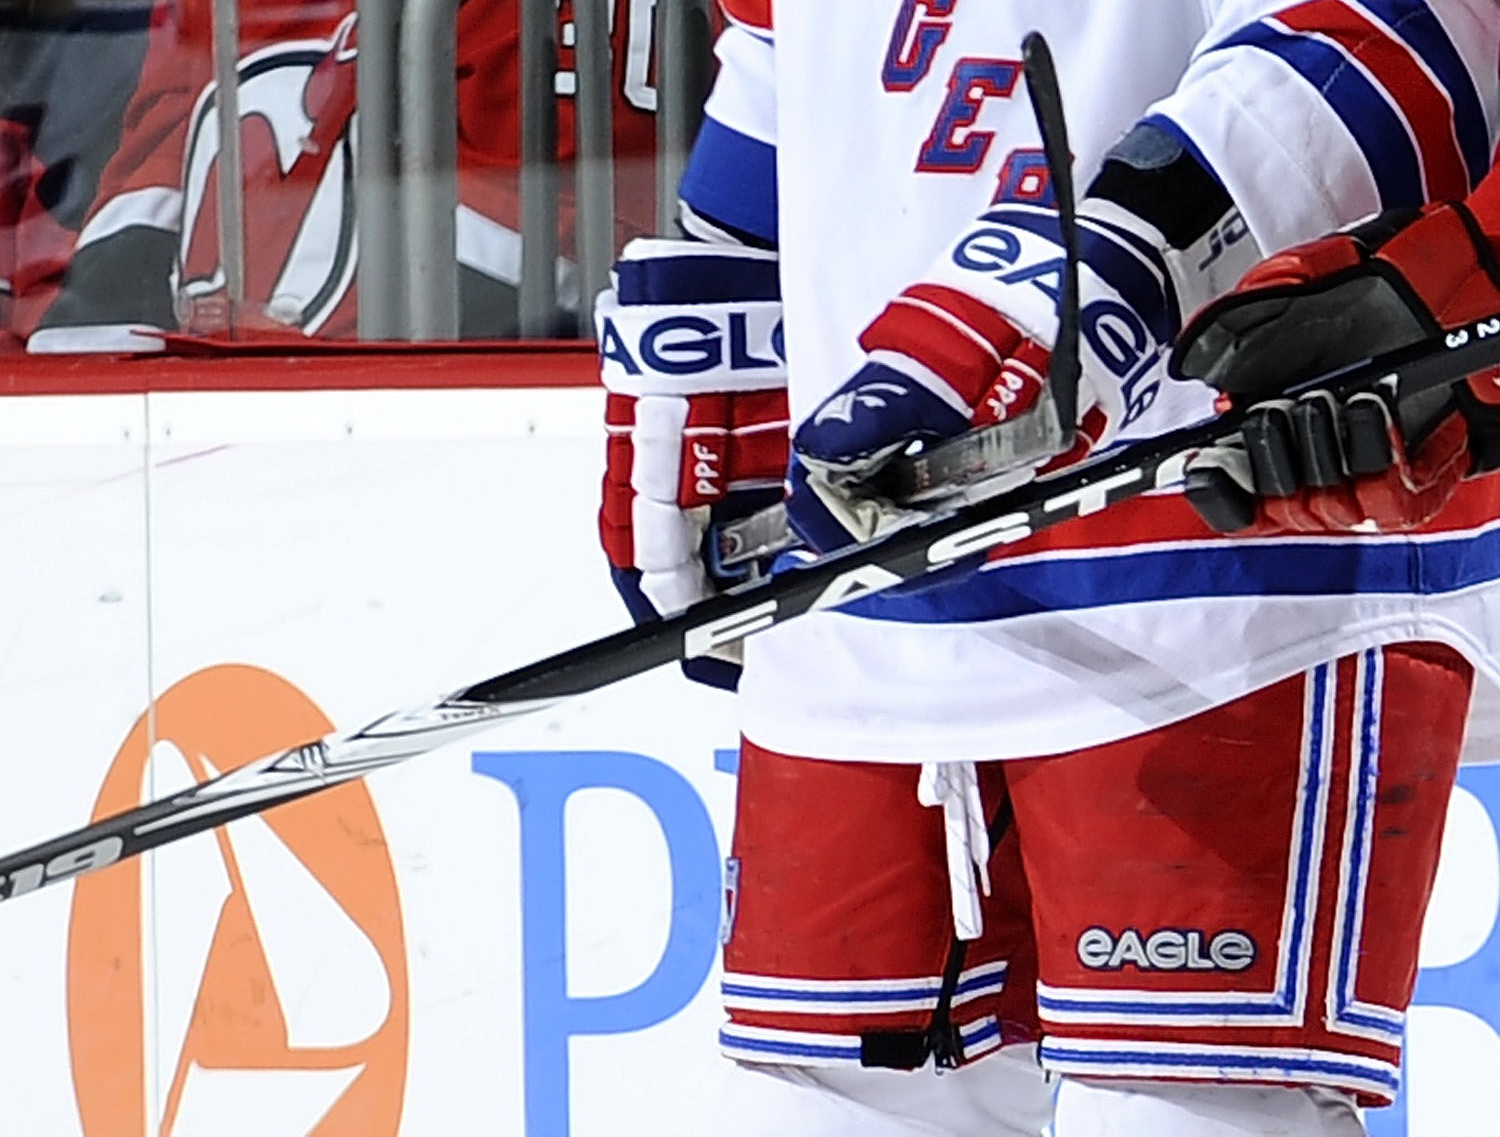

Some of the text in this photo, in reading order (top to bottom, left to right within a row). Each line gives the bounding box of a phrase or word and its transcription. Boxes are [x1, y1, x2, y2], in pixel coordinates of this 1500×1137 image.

[603, 312, 785, 376] AGL
[693, 442, 720, 495] PPF
[684, 450, 1192, 659] EAST
